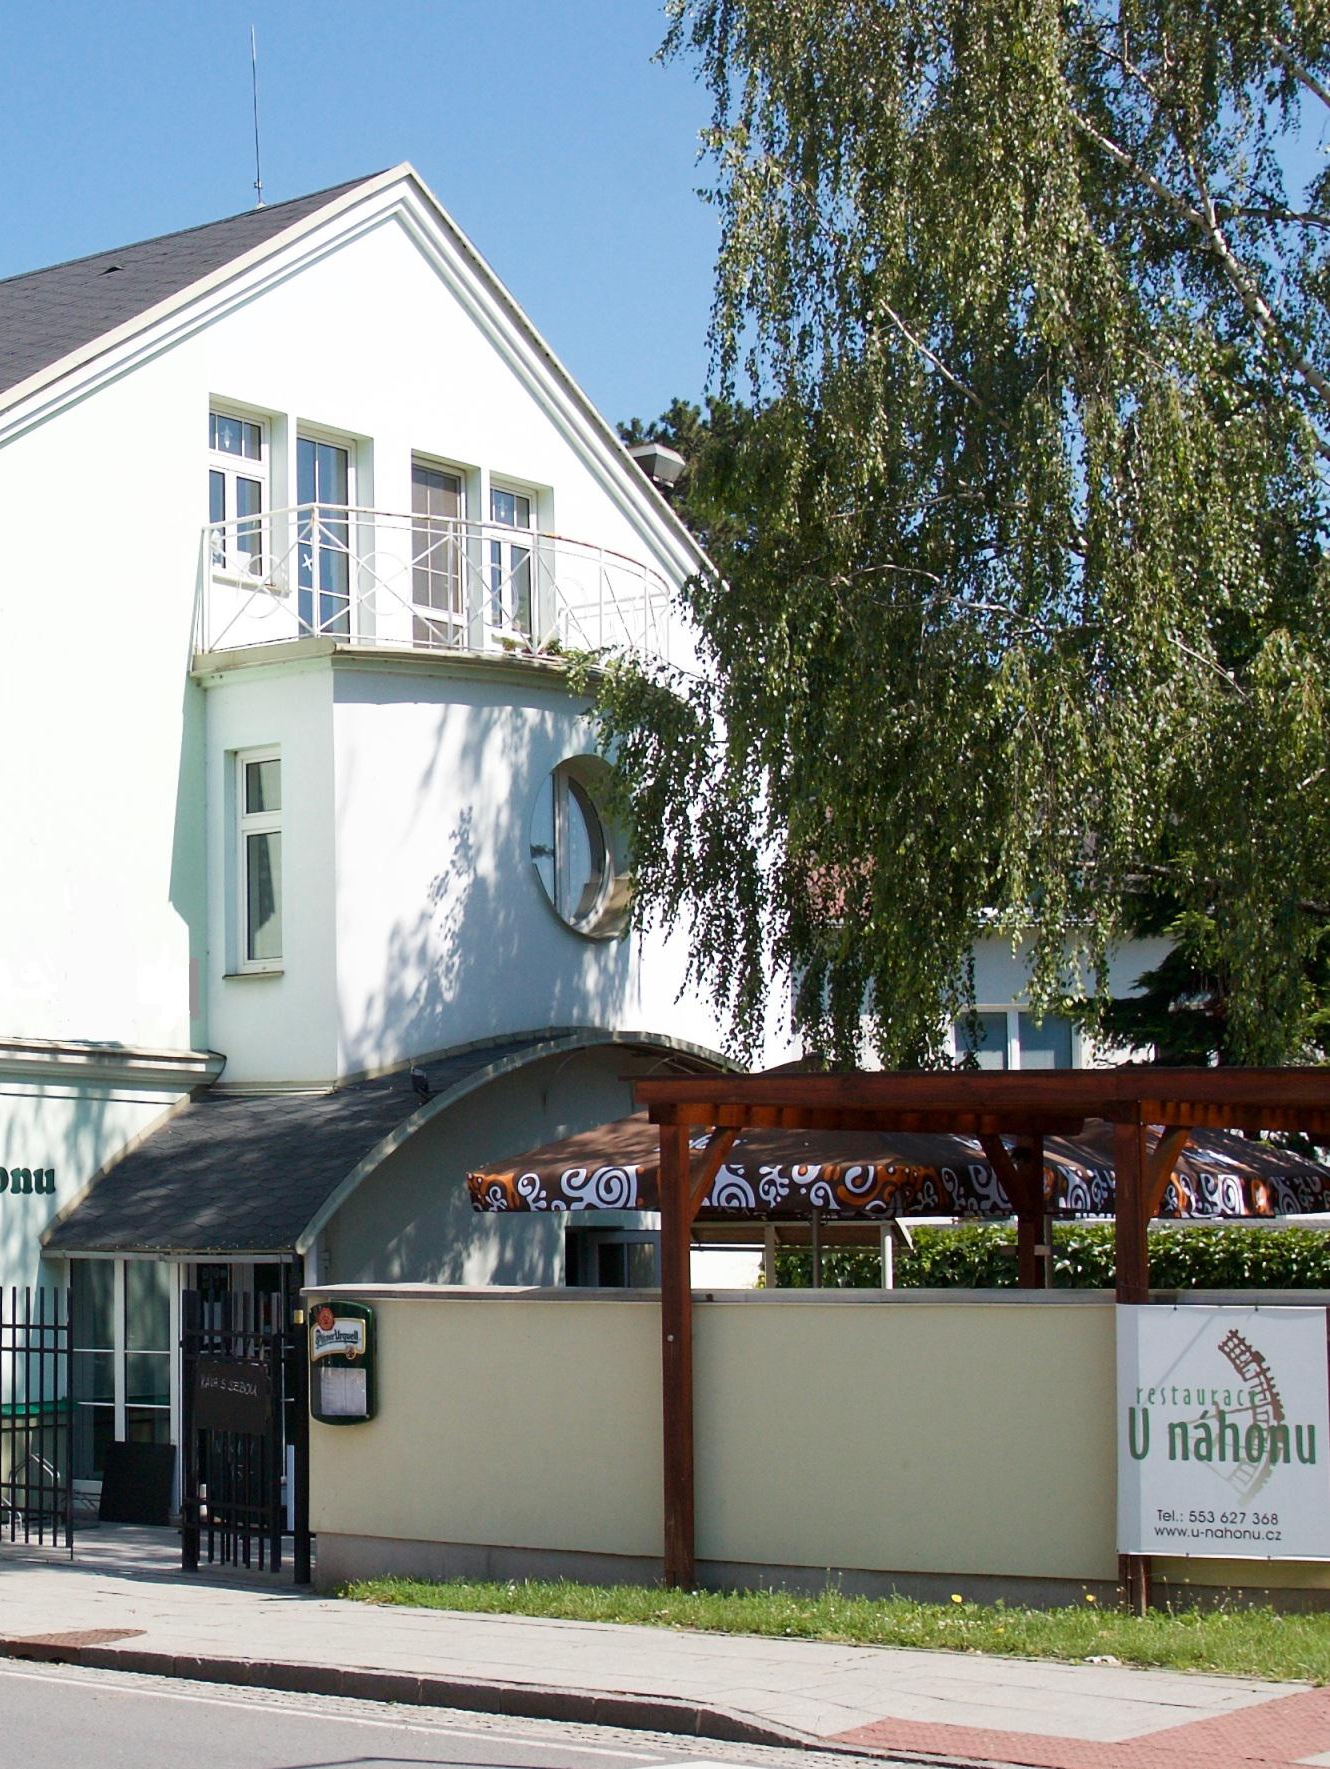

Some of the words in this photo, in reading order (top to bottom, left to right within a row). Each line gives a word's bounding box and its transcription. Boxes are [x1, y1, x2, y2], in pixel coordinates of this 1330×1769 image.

[1136, 1386, 1257, 1406] restaurace
[1128, 1406, 1150, 1460] U
[1167, 1409, 1316, 1465] náhonu
[1157, 1509, 1183, 1522] Tel.:
[1189, 1510, 1215, 1523] 553
[1220, 1511, 1247, 1524] 627
[1252, 1512, 1279, 1525] 368
[1154, 1526, 1282, 1541] www.u-nahonu.cz
